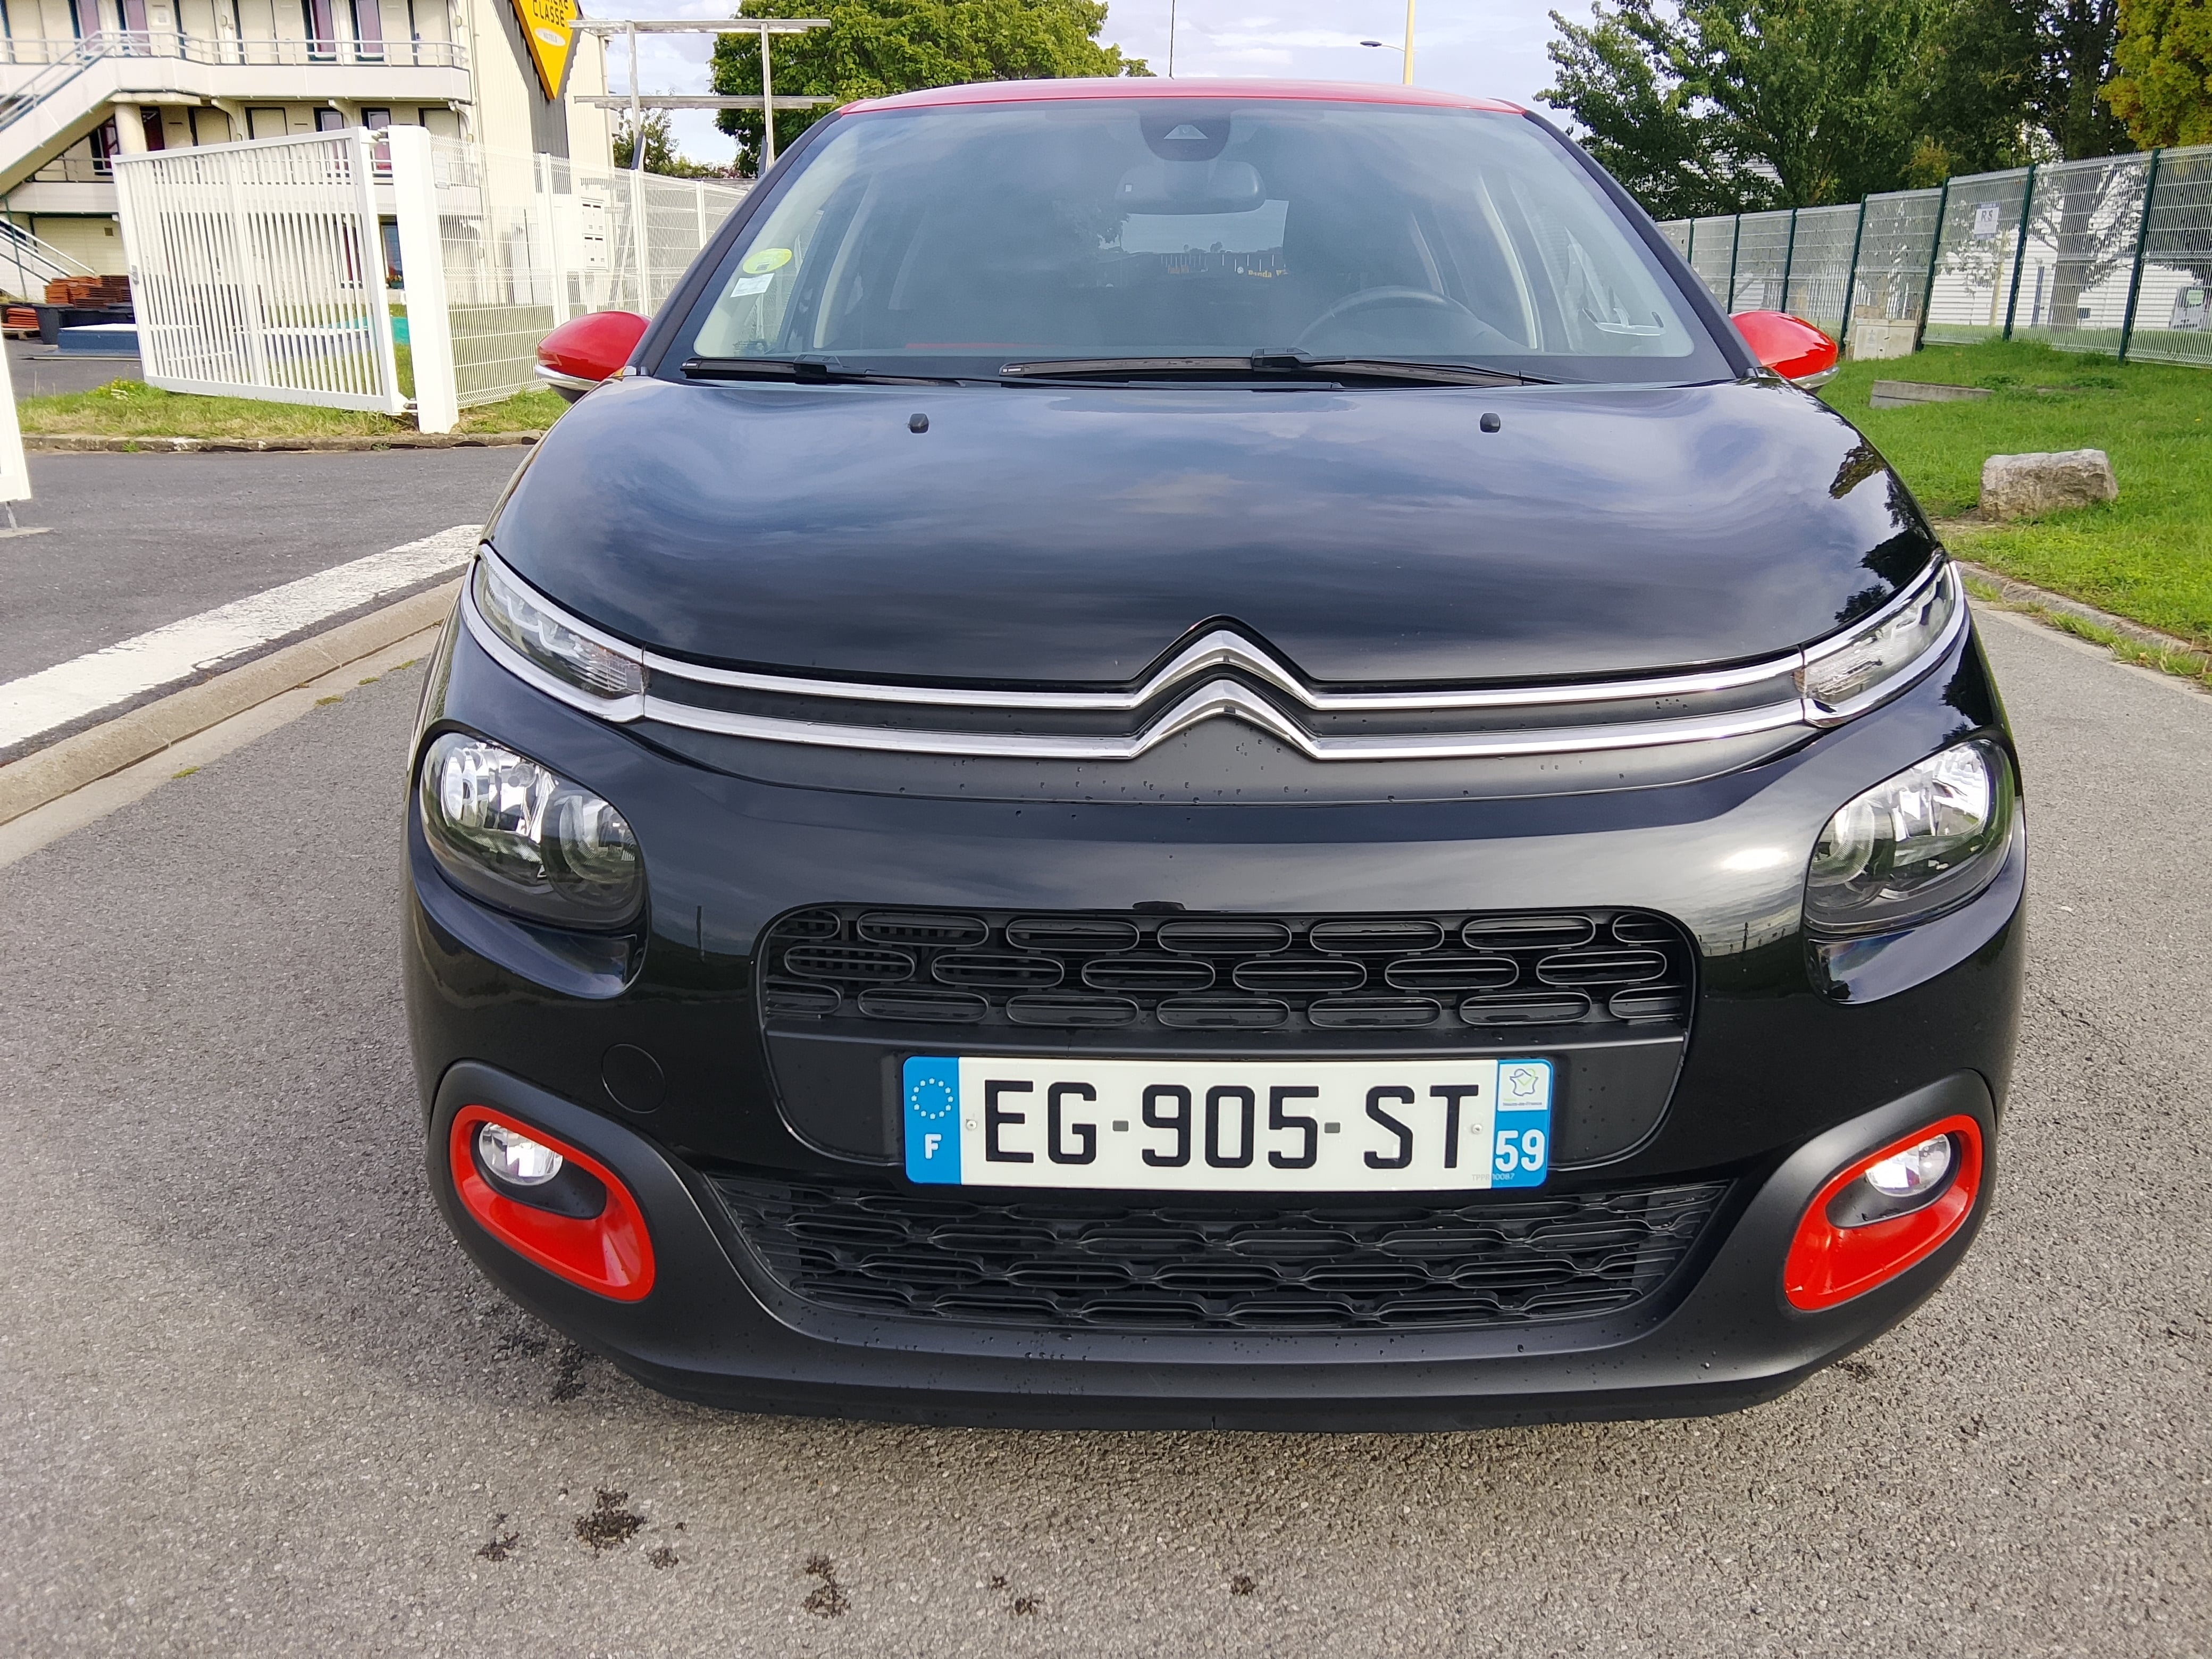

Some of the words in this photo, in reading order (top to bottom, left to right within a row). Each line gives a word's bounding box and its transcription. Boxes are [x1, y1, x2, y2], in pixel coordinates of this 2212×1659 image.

[532, 0, 565, 28] CLASSE
[925, 1133, 942, 1159] F
[1495, 1129, 1545, 1172] 59
